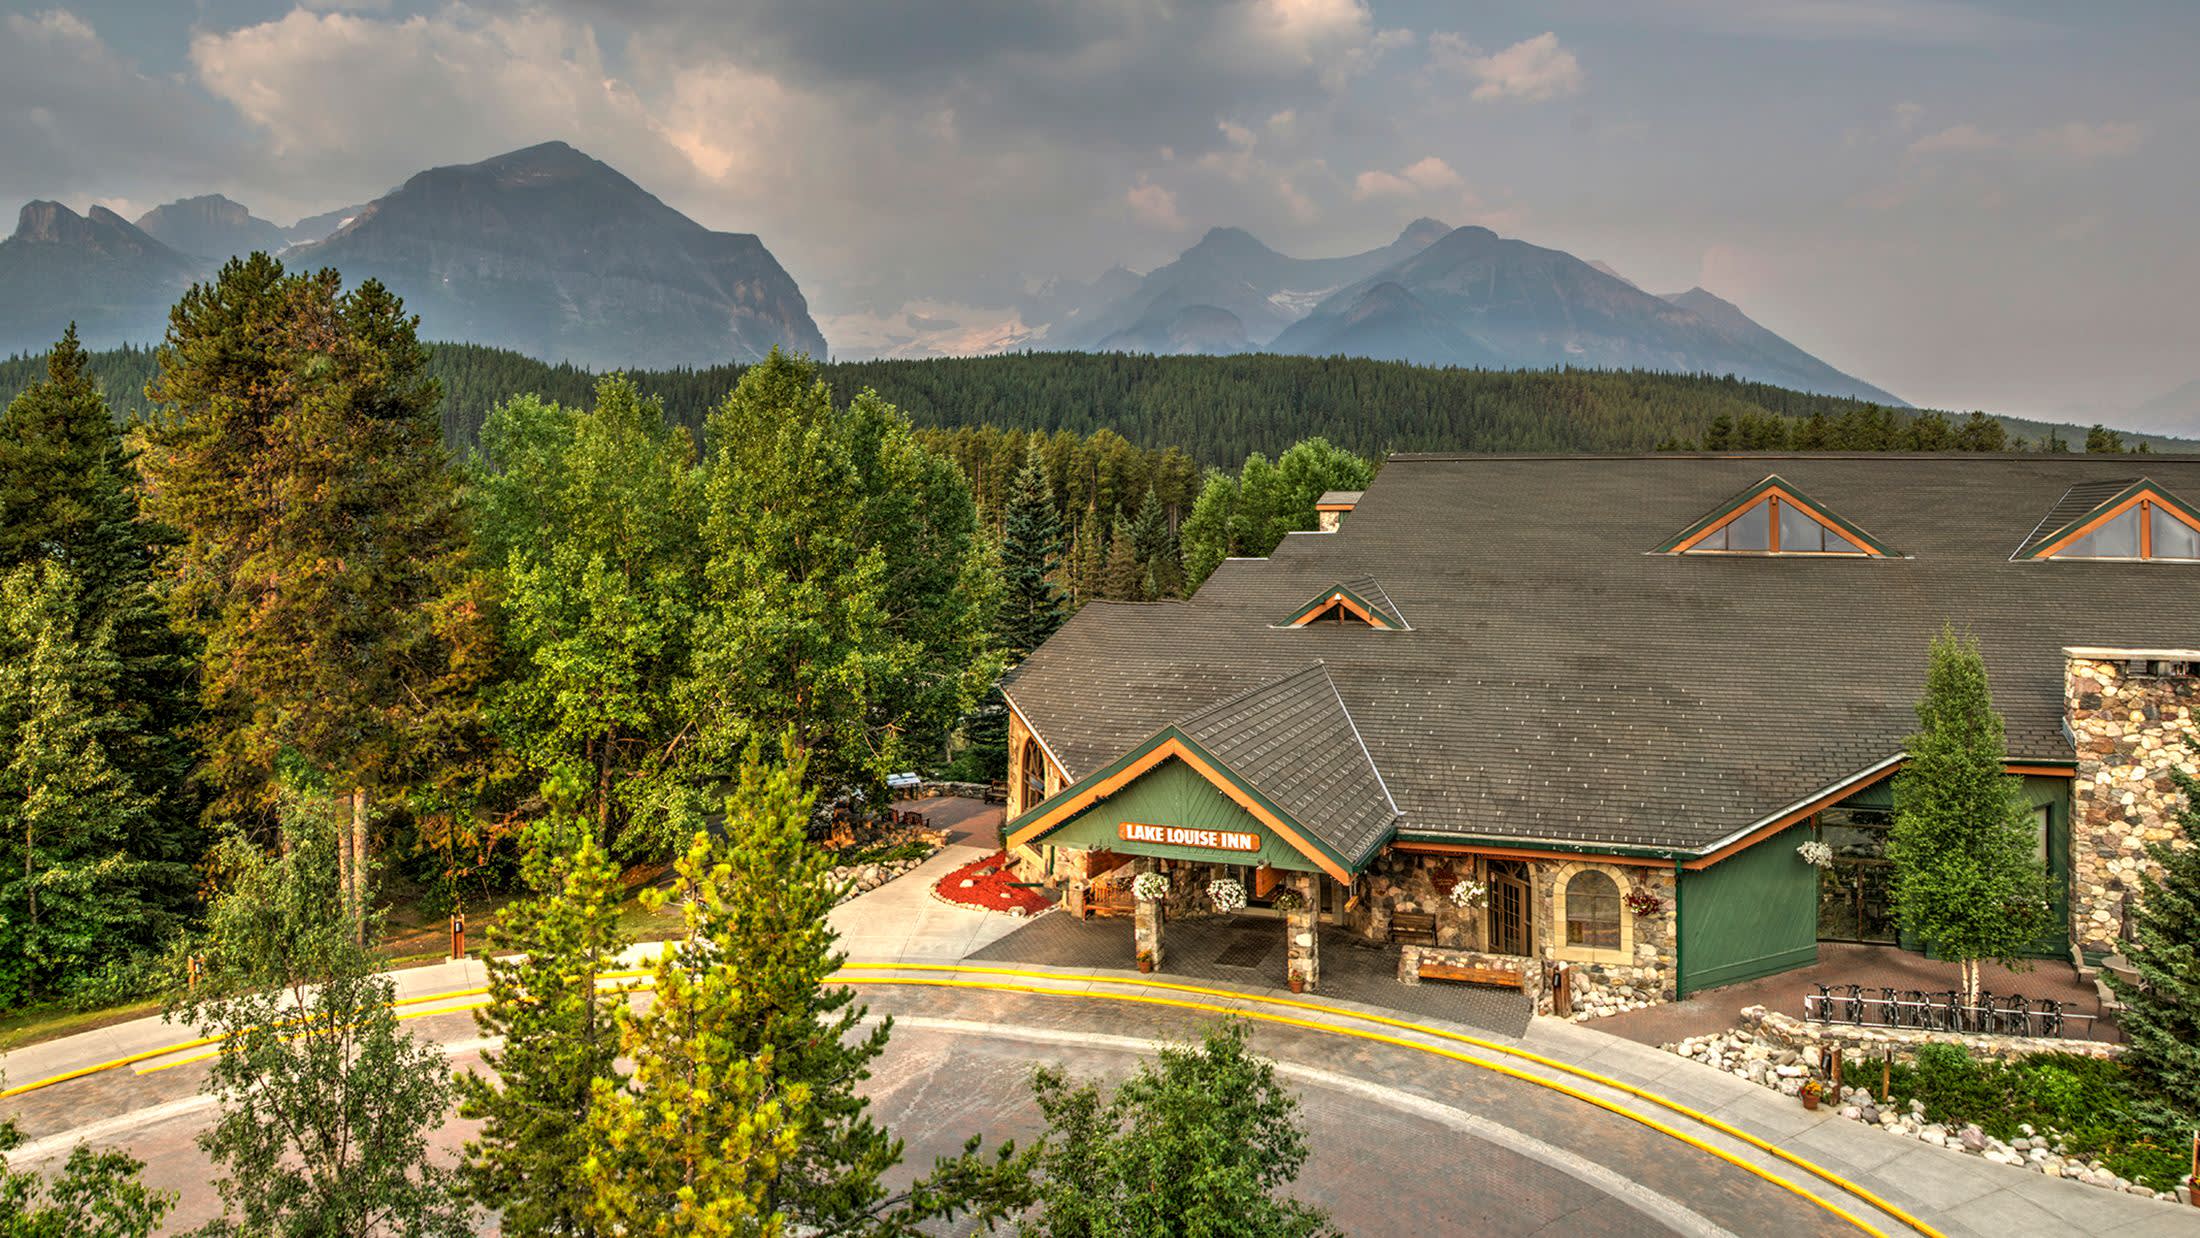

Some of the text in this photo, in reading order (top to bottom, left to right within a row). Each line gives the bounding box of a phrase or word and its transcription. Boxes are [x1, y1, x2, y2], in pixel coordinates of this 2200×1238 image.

[1126, 824, 1252, 849] LAKE LOUISE INN
